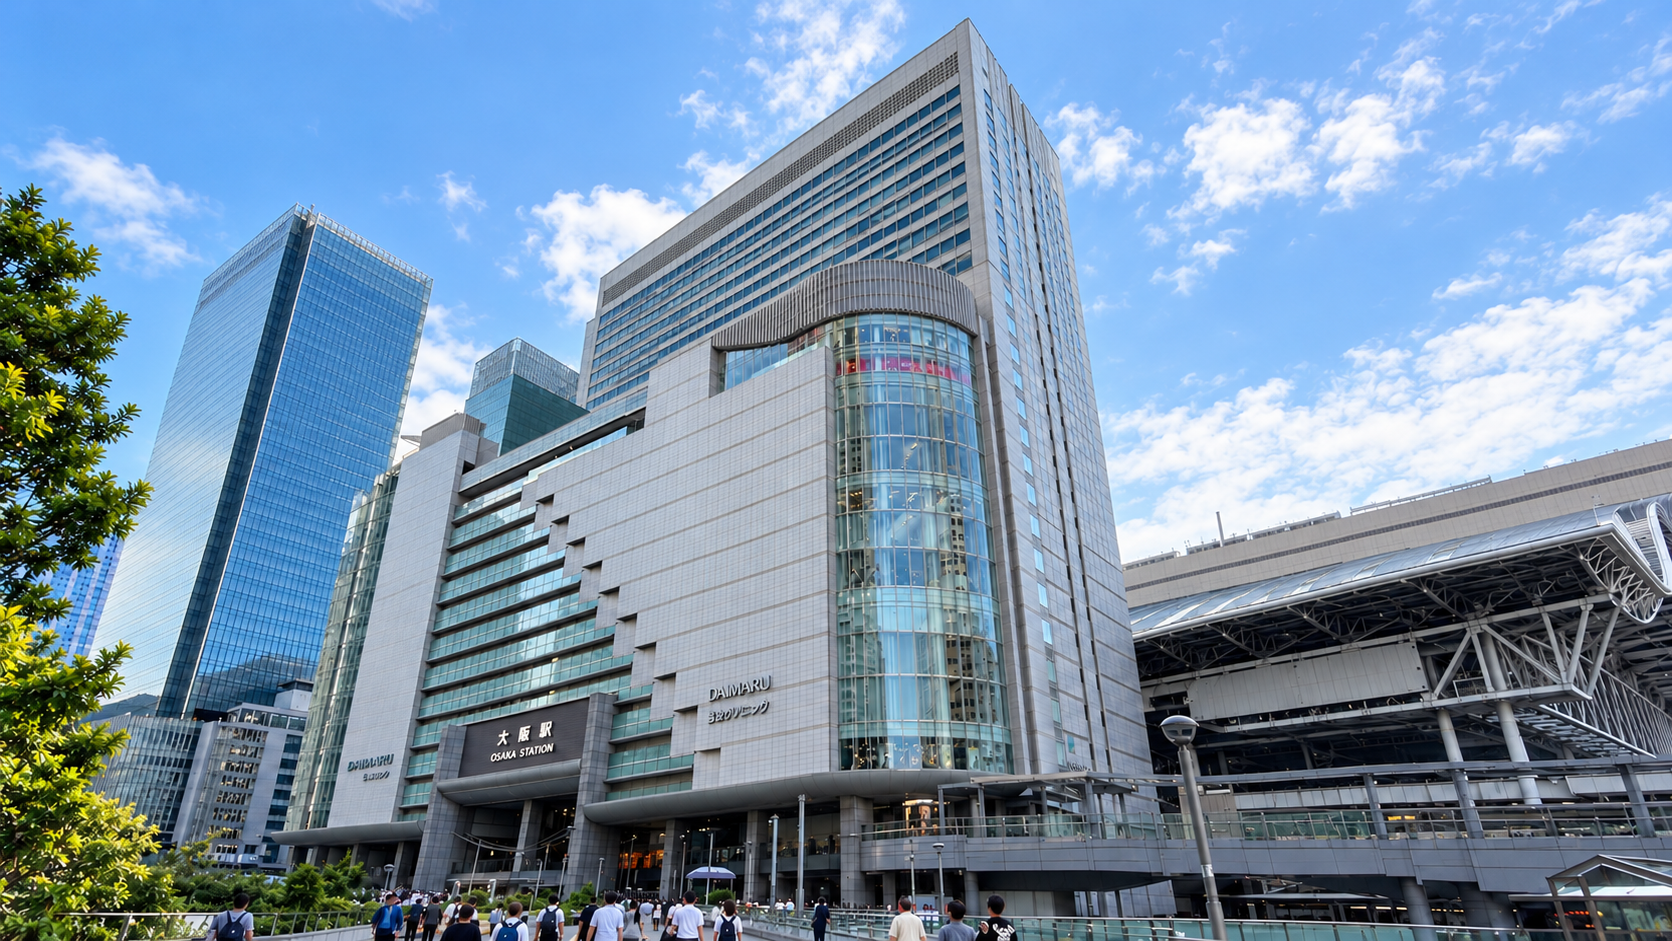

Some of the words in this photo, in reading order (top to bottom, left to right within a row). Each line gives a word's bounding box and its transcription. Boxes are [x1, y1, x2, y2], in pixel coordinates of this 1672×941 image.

[708, 675, 772, 702] DAIMARU
[497, 720, 553, 747] 大阪駅
[490, 750, 517, 763] OSAKA
[519, 743, 554, 758] STATION
